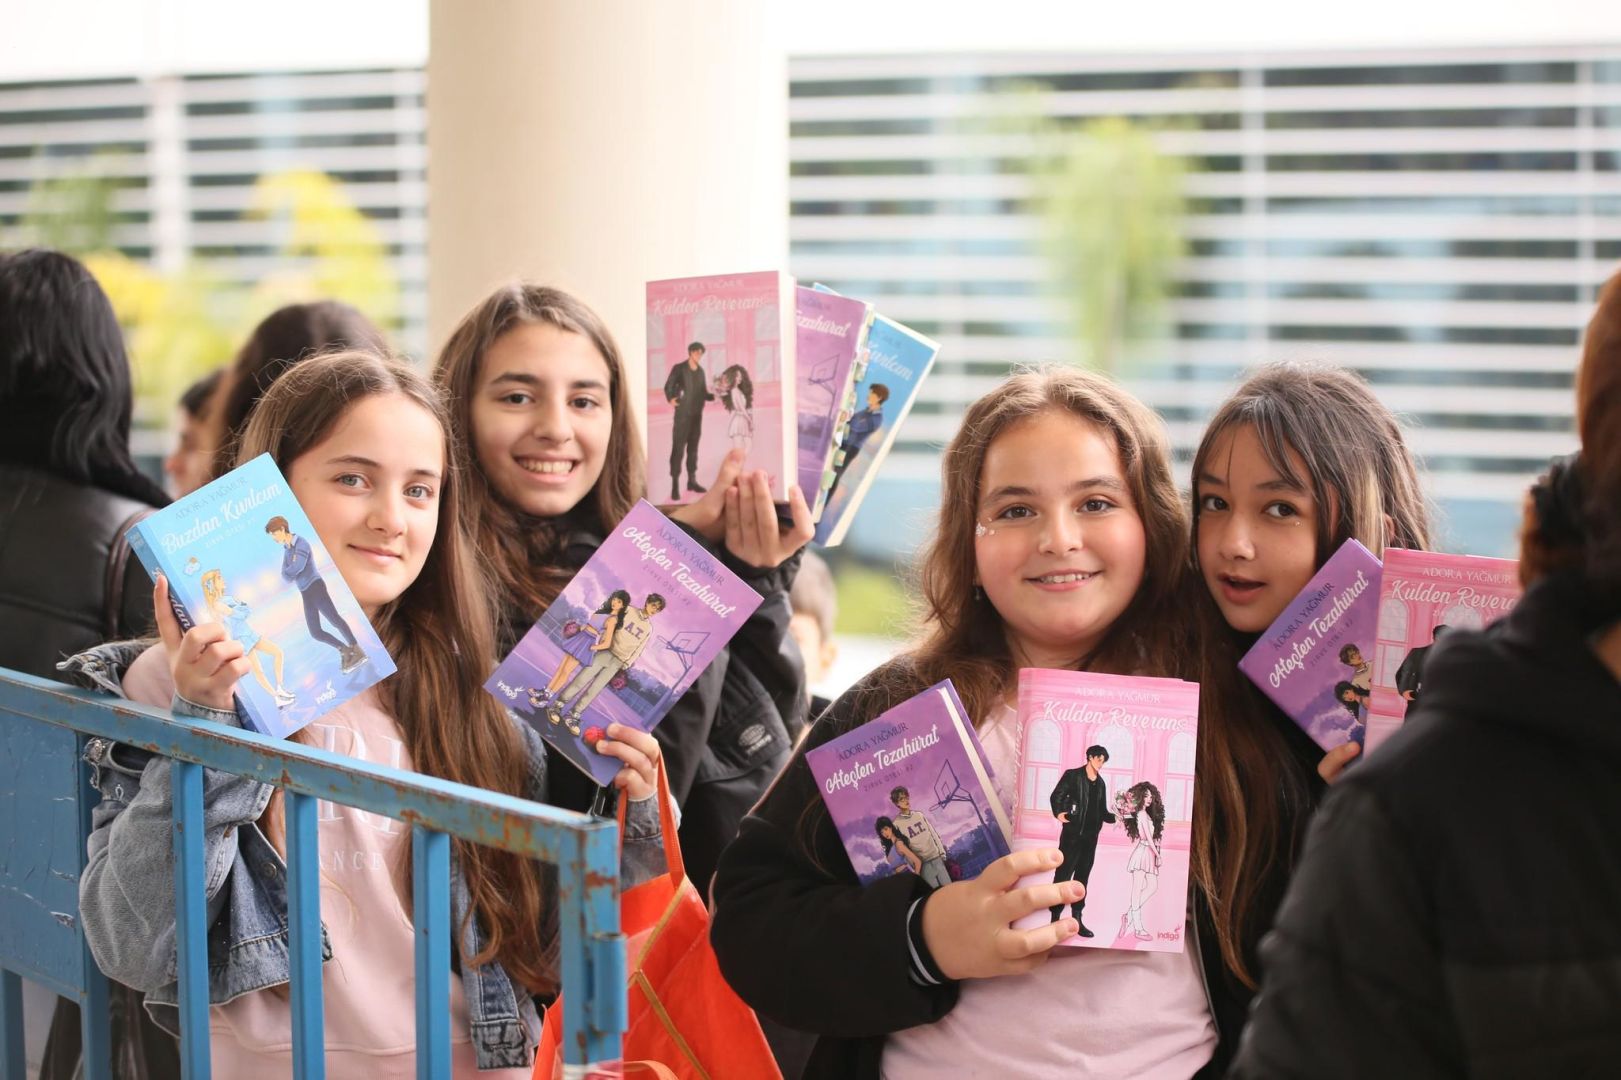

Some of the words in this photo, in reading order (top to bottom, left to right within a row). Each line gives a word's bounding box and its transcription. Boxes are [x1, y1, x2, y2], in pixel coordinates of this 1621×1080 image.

[160, 515, 222, 554] Buzdan
[219, 482, 283, 522] Kıvılcım
[622, 526, 673, 571] Ateşten
[671, 562, 737, 618] Tezahürat
[656, 525, 689, 557] ADORA
[690, 551, 726, 586] YAĞMUR
[1422, 566, 1463, 579] ADORA
[1466, 568, 1512, 584] YAĞMUR
[1272, 619, 1303, 652] ADORA
[1300, 582, 1336, 618] YAĞMUR
[1392, 579, 1451, 604] Külden
[1269, 636, 1316, 688] Ateşten
[1308, 570, 1369, 638] Tezahürat
[838, 741, 870, 761] ADORA
[870, 722, 909, 746] YAĞMUR
[1109, 705, 1188, 731] Reverans
[825, 761, 876, 794] Ateşten
[873, 723, 940, 770] Tezahürat
[1157, 931, 1180, 942] indigo
